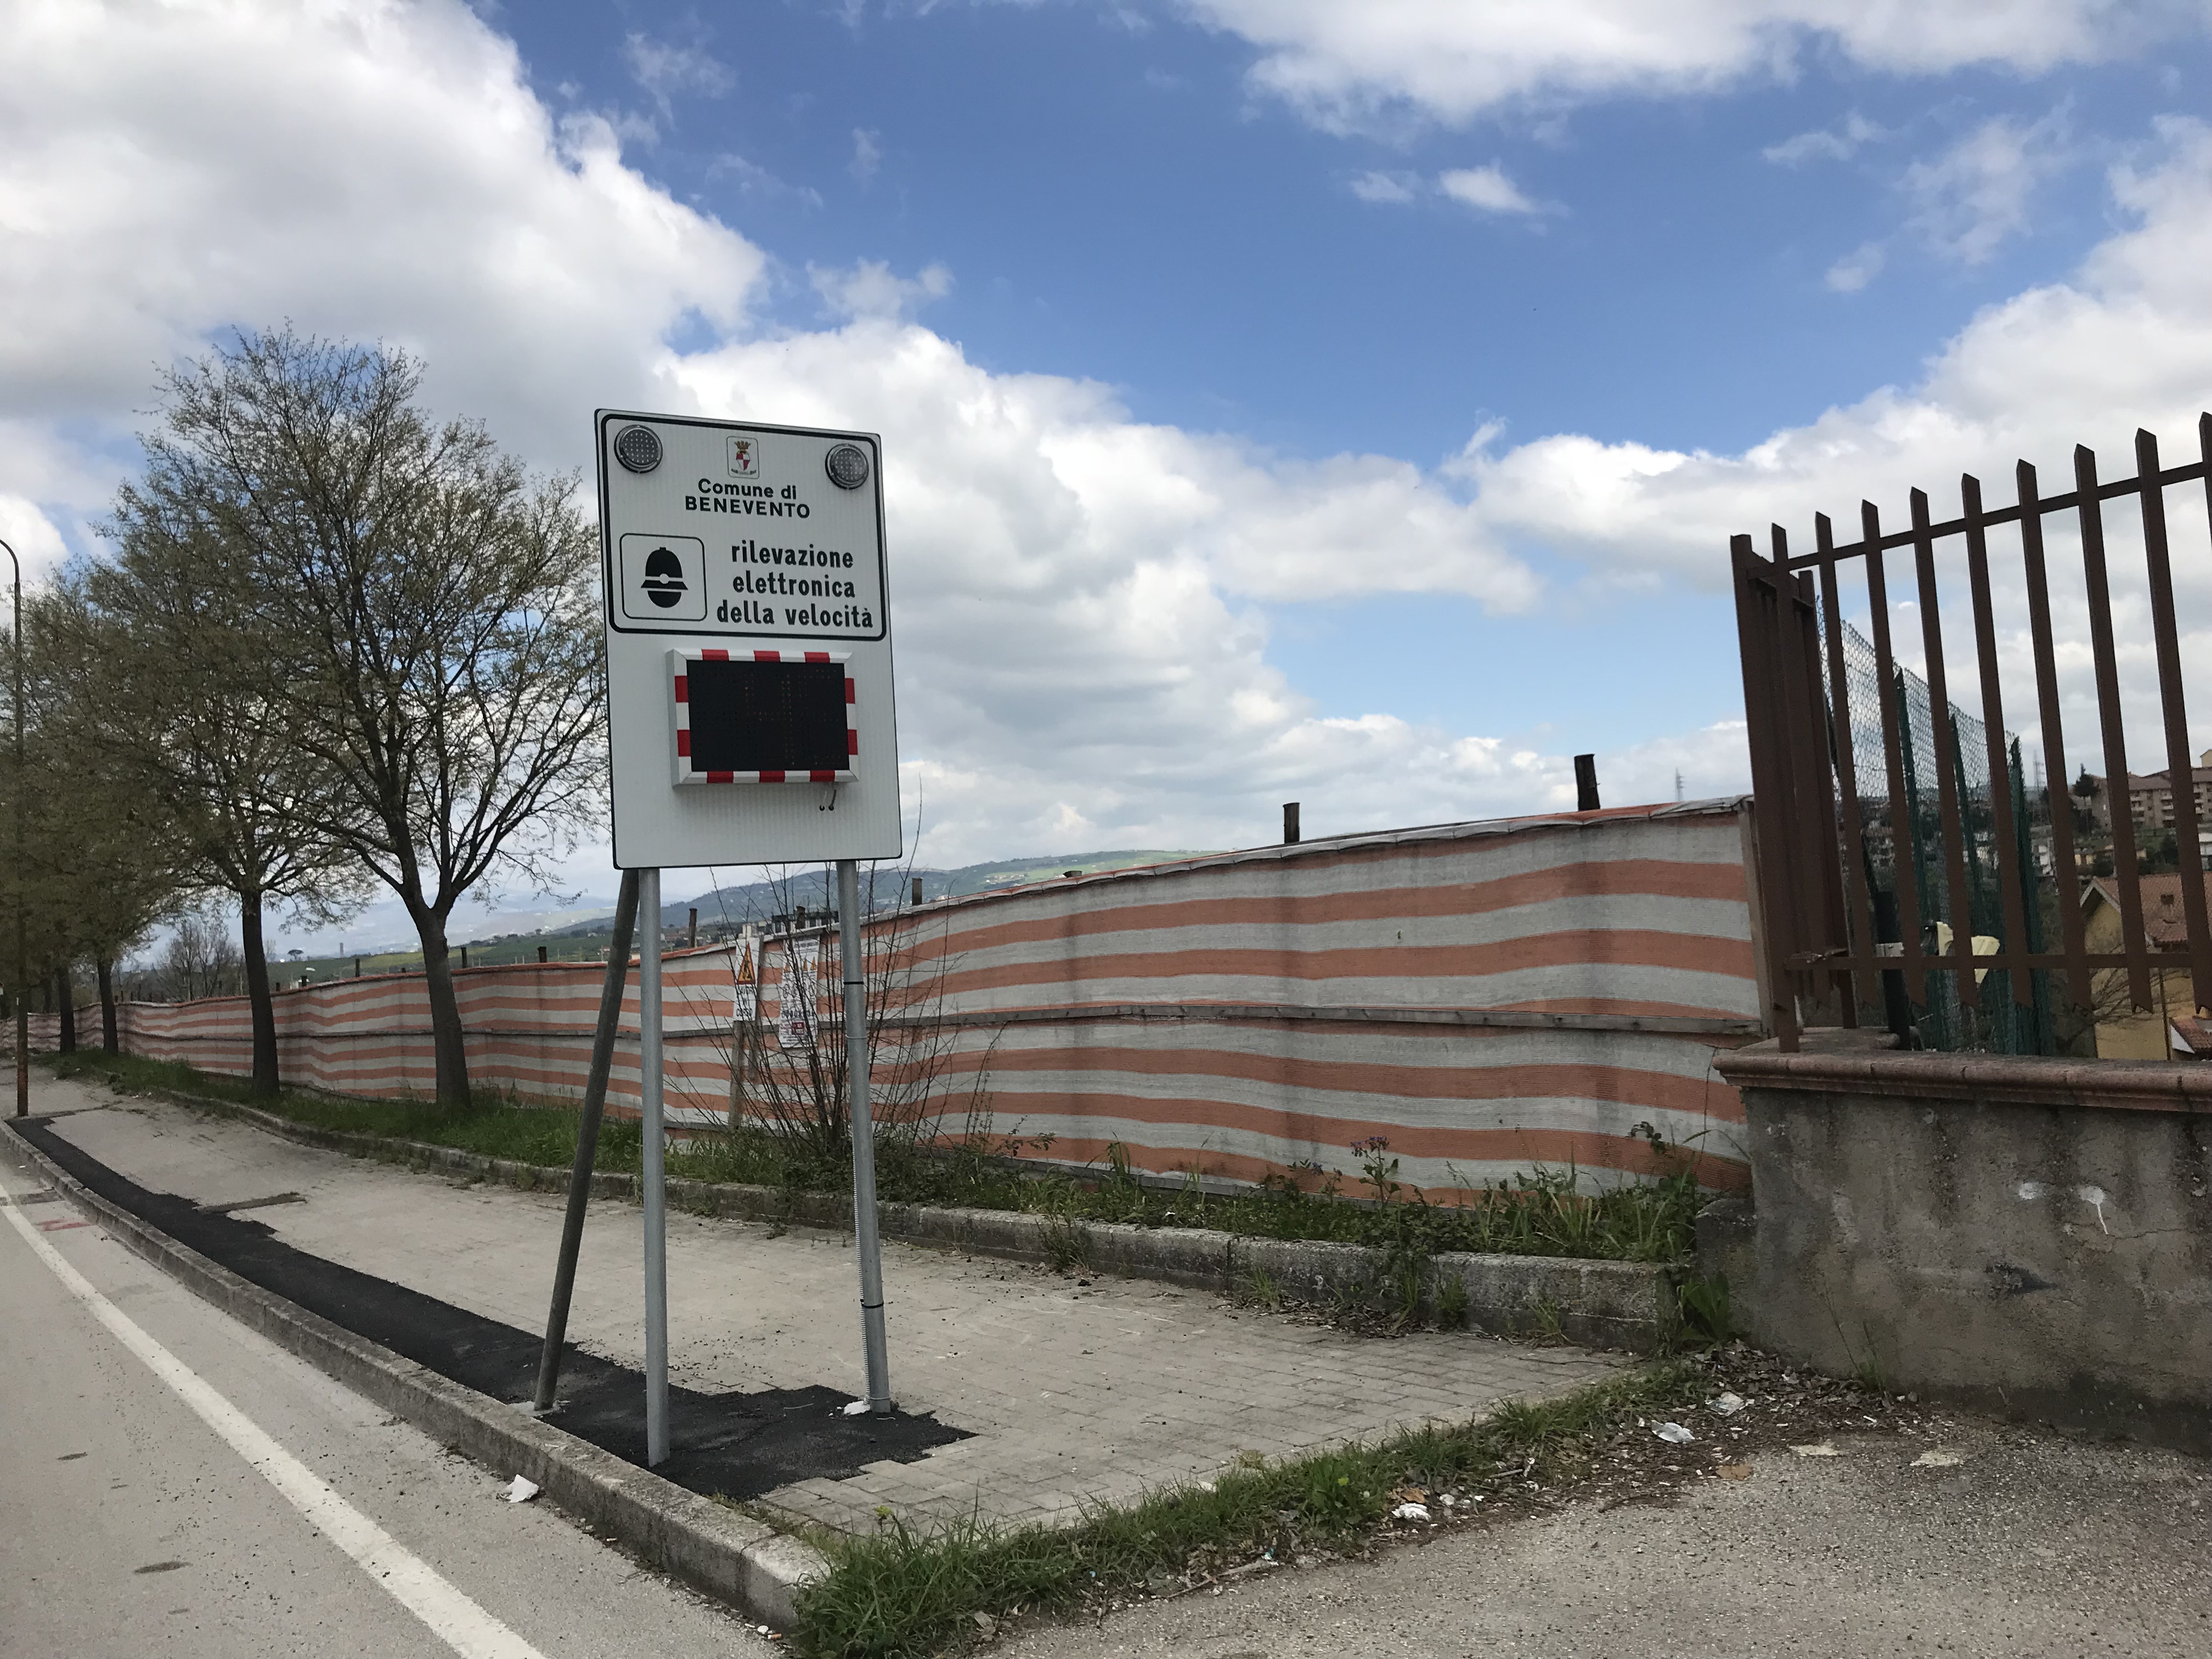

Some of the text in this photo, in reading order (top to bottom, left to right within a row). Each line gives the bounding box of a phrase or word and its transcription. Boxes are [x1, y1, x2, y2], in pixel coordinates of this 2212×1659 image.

[698, 478, 797, 500] Comune di
[685, 495, 810, 518] BENEVENTO
[731, 539, 854, 568] rilevazione
[732, 570, 855, 598] elettronica
[716, 599, 873, 628] della velocità
